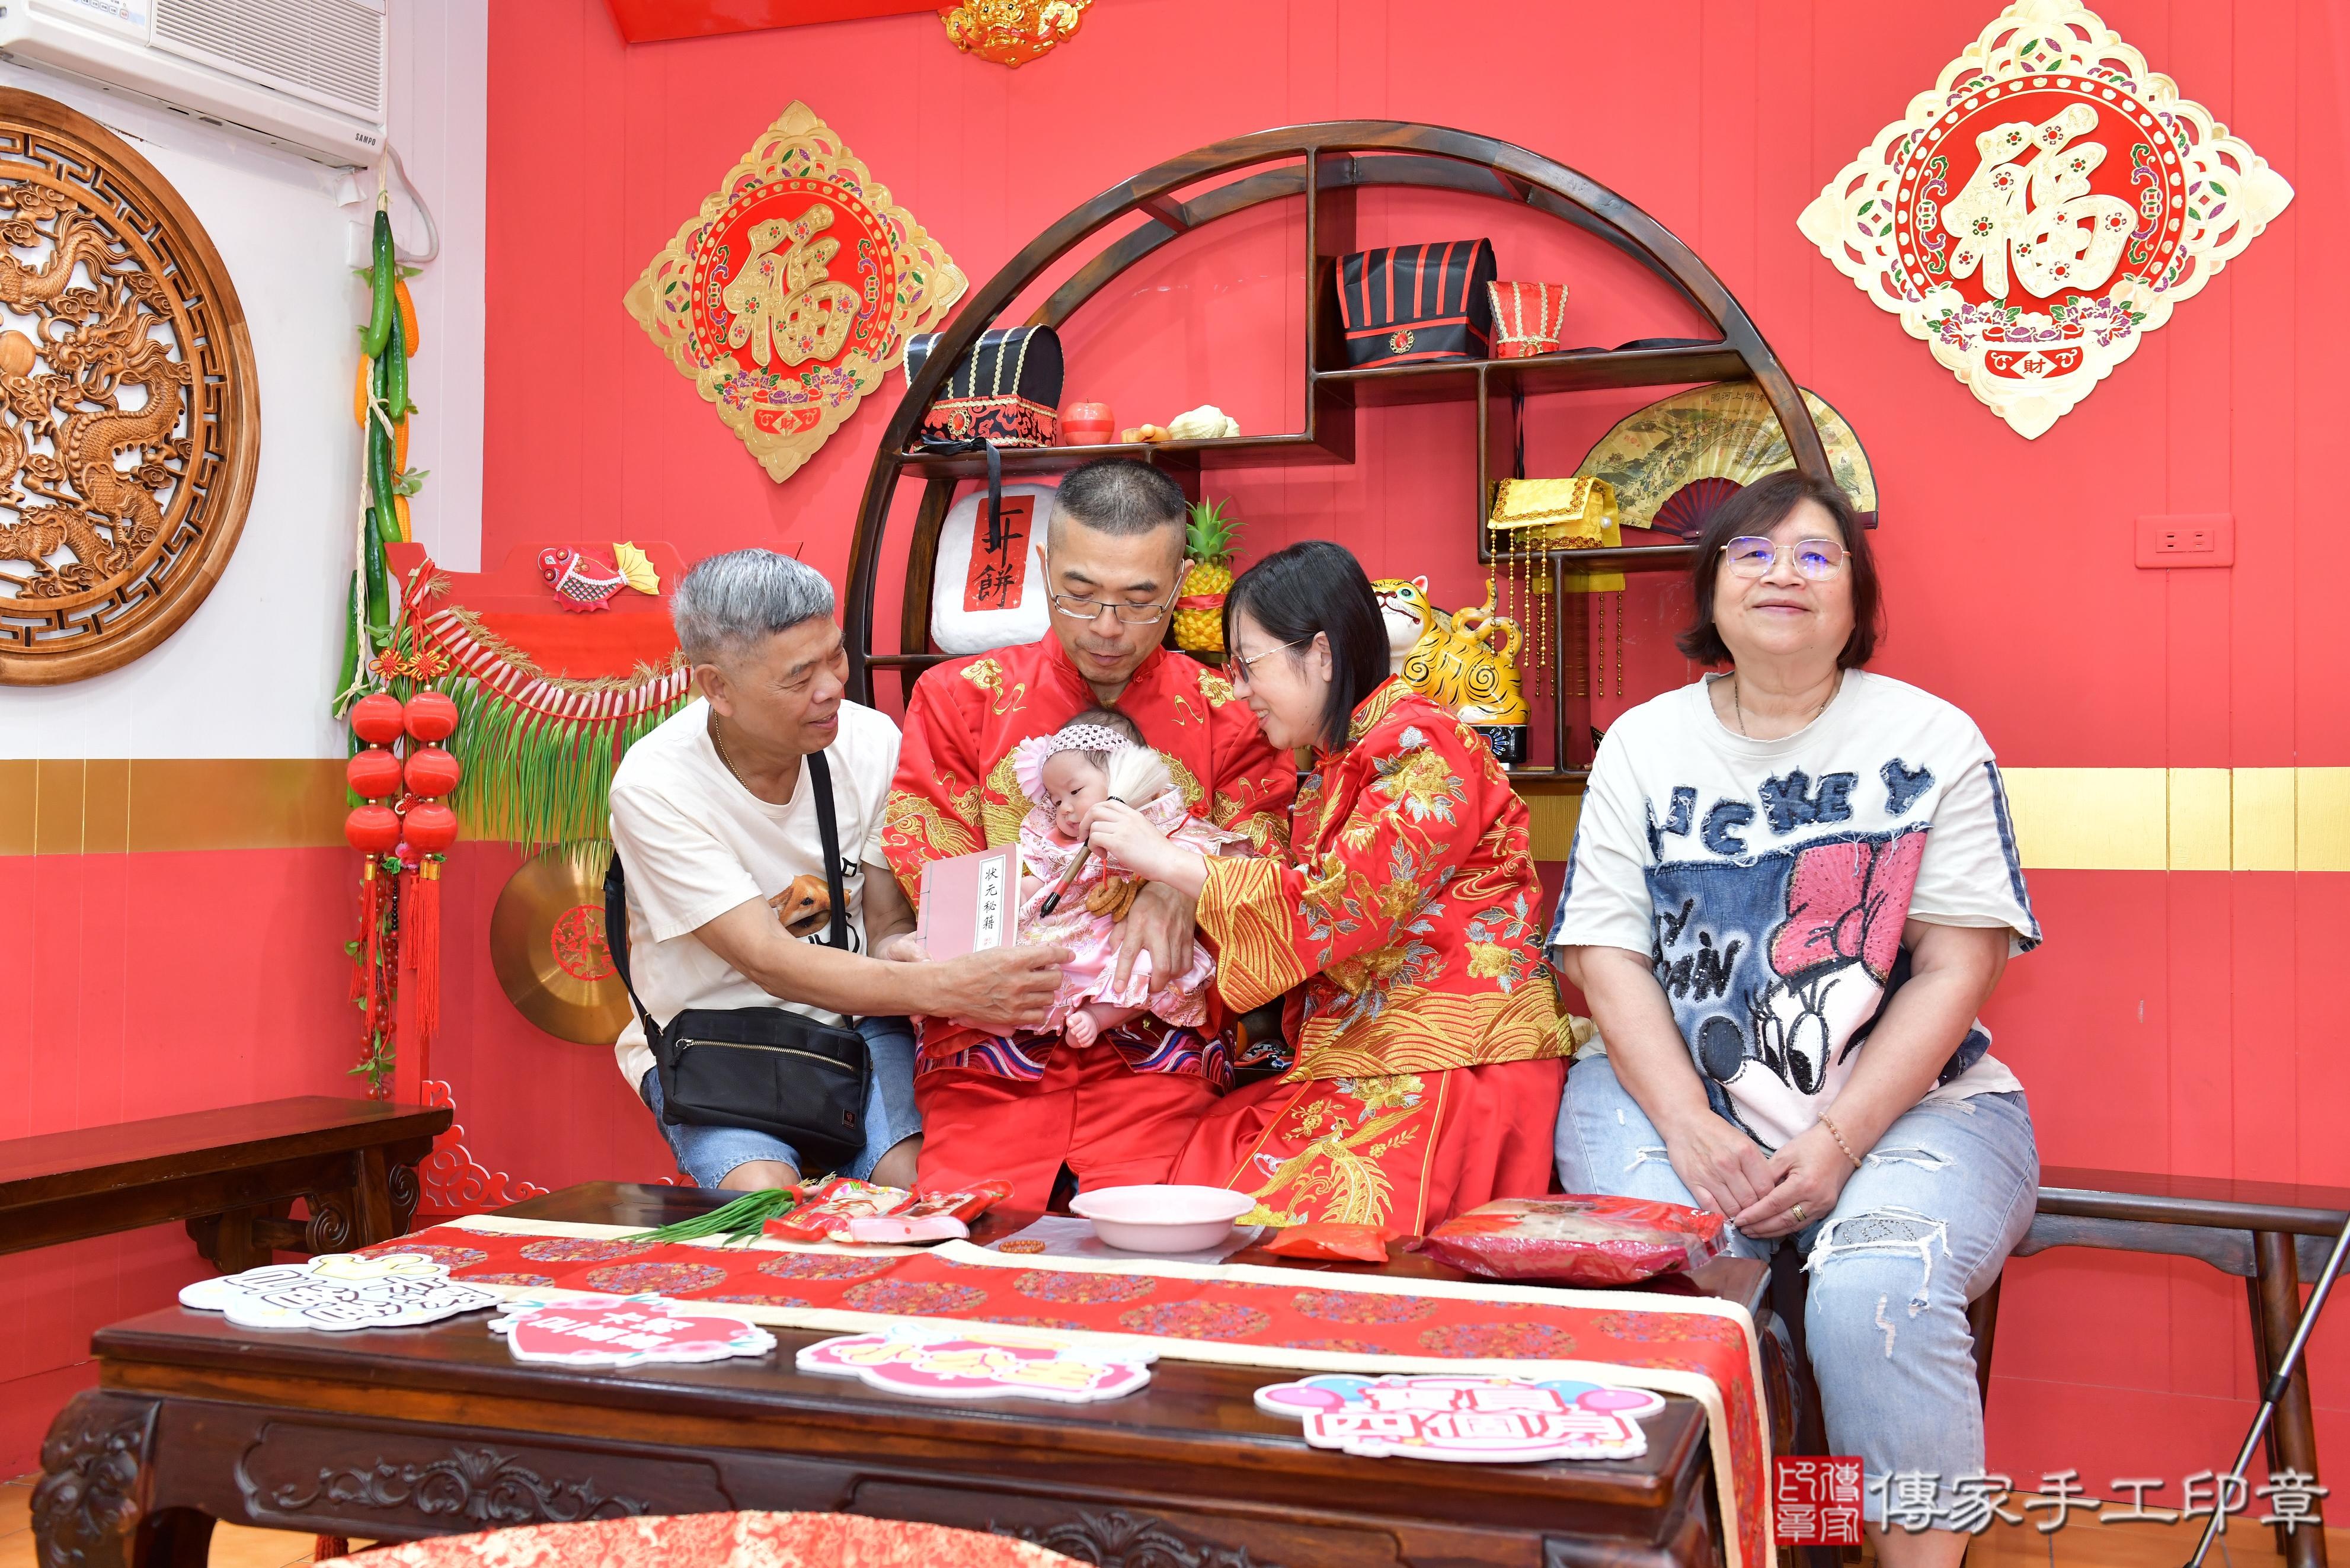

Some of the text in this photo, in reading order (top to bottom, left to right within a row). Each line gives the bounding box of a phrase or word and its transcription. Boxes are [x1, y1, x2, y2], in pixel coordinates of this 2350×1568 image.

[355, 133, 376, 146] SAMPO
[1940, 103, 2138, 299] 福
[722, 203, 861, 367] 福
[2023, 359, 2047, 373] 財
[779, 417, 797, 430] 財
[835, 1342, 1107, 1388] 小公主
[1319, 1413, 1624, 1439] 四個月
